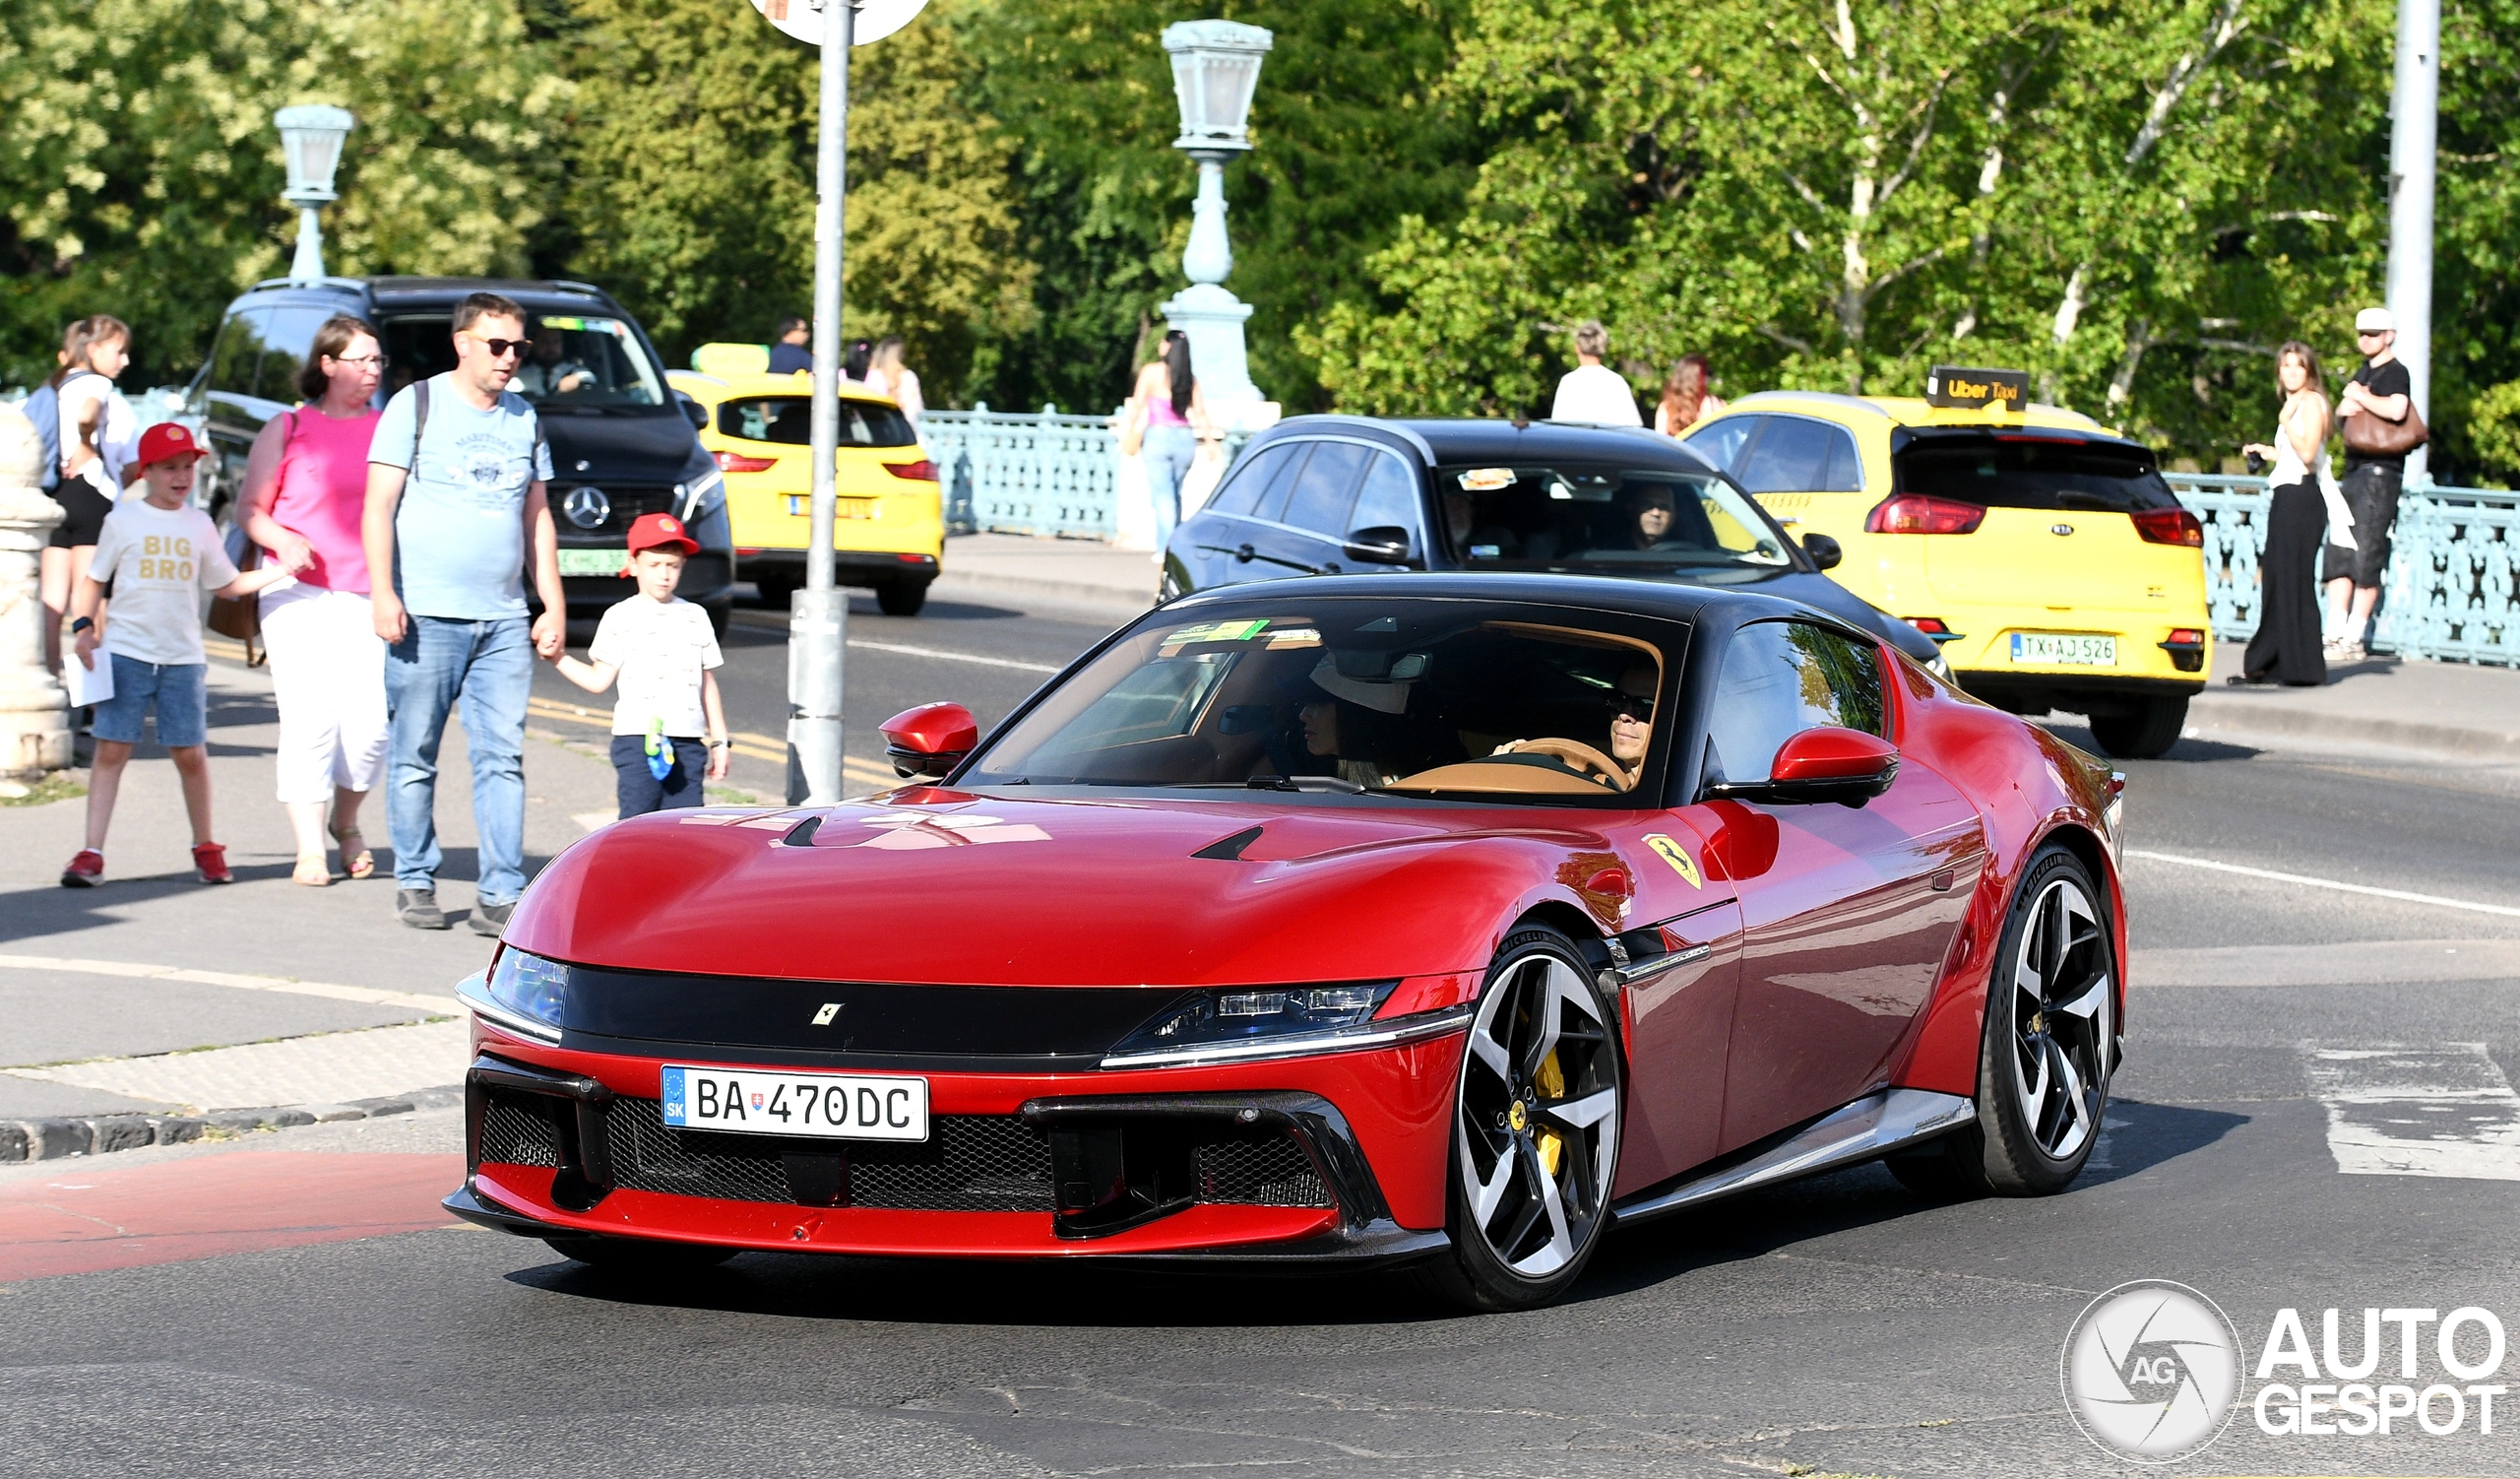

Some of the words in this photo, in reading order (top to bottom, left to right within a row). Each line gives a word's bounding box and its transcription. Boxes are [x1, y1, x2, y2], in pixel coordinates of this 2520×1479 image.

[1948, 379, 1988, 399] Uber
[1990, 381, 2018, 401] Taxi
[144, 535, 192, 558] BIG
[139, 558, 193, 582] BRO
[2026, 637, 2047, 656] TX
[2026, 854, 2062, 895] MICHELIN
[1500, 931, 1550, 955] MICHELIN
[666, 1103, 684, 1118] SK
[698, 1079, 746, 1121] BA
[768, 1083, 911, 1128] 470DC
